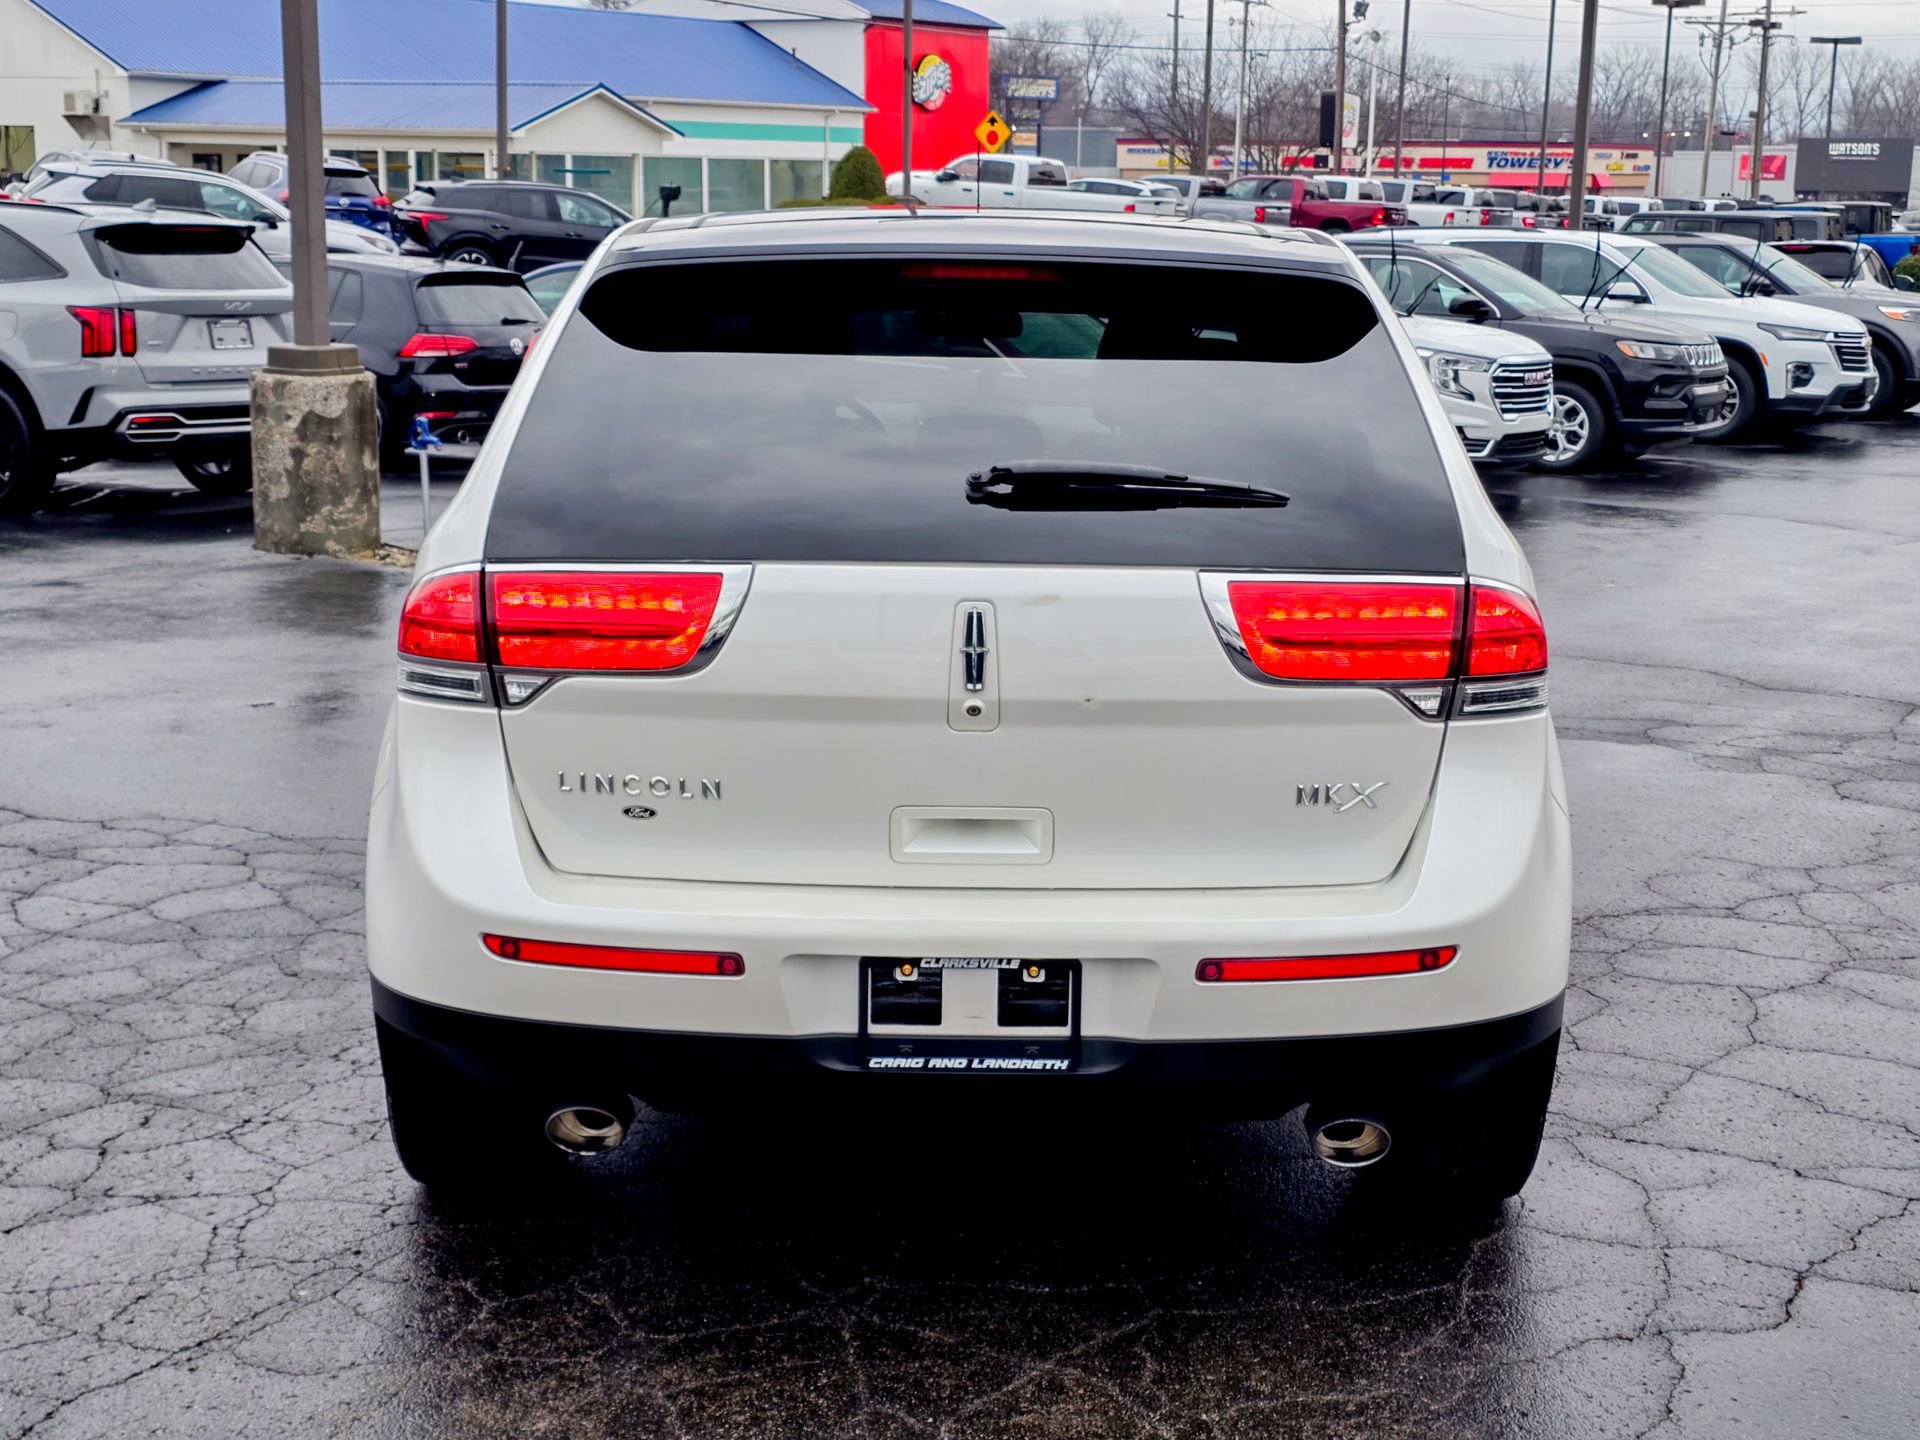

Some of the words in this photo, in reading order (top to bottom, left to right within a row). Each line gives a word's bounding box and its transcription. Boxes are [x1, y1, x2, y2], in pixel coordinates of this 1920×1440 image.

[1829, 142, 1880, 155] WATSON'S
[1487, 157, 1574, 169] TOWERY'S
[558, 770, 721, 800] LINCOLN
[1296, 781, 1391, 813] MKX
[627, 807, 652, 818] Ford
[920, 958, 1021, 969] CLARKSVILLE
[868, 1057, 925, 1069] CRAIG
[928, 1058, 968, 1070] AND
[971, 1058, 1070, 1071] LANDRETH
